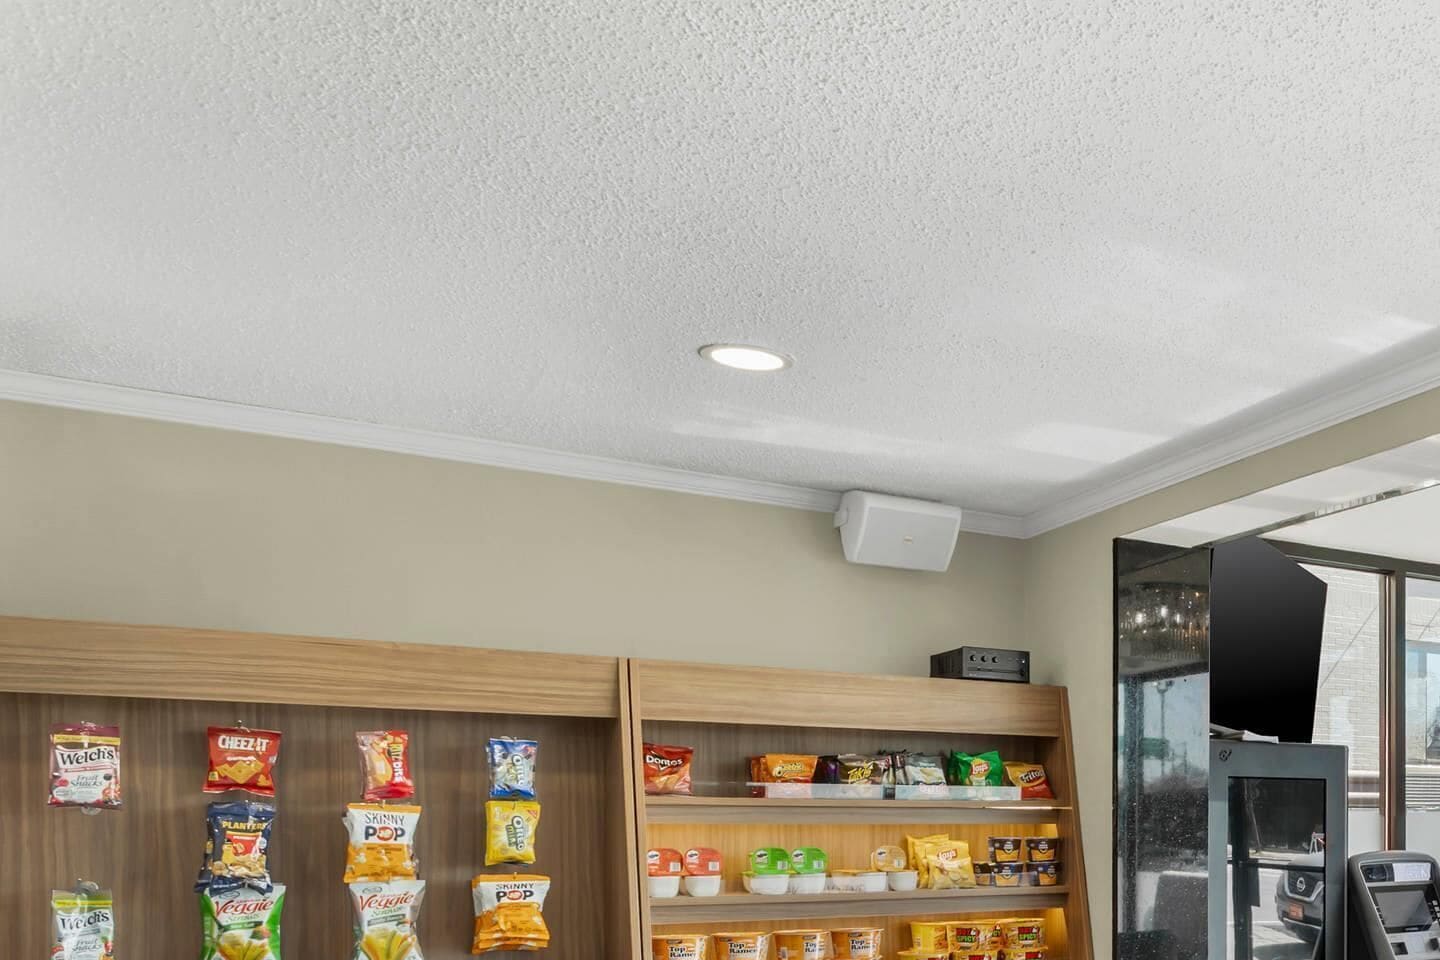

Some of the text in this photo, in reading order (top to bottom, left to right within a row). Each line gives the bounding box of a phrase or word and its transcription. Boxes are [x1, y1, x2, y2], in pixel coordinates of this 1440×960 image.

[60, 747, 114, 766] Welch's
[645, 754, 684, 768] Doritos
[364, 812, 406, 826] SKINNY
[222, 820, 268, 833] PLANTERS
[364, 826, 406, 841] POP
[511, 815, 525, 852] OREO
[495, 882, 535, 890] SKINNY
[360, 891, 415, 911] Veggie
[495, 890, 535, 902] POP
[215, 899, 273, 916] Veggie
[60, 910, 110, 930] Welch's
[729, 942, 745, 950] Top
